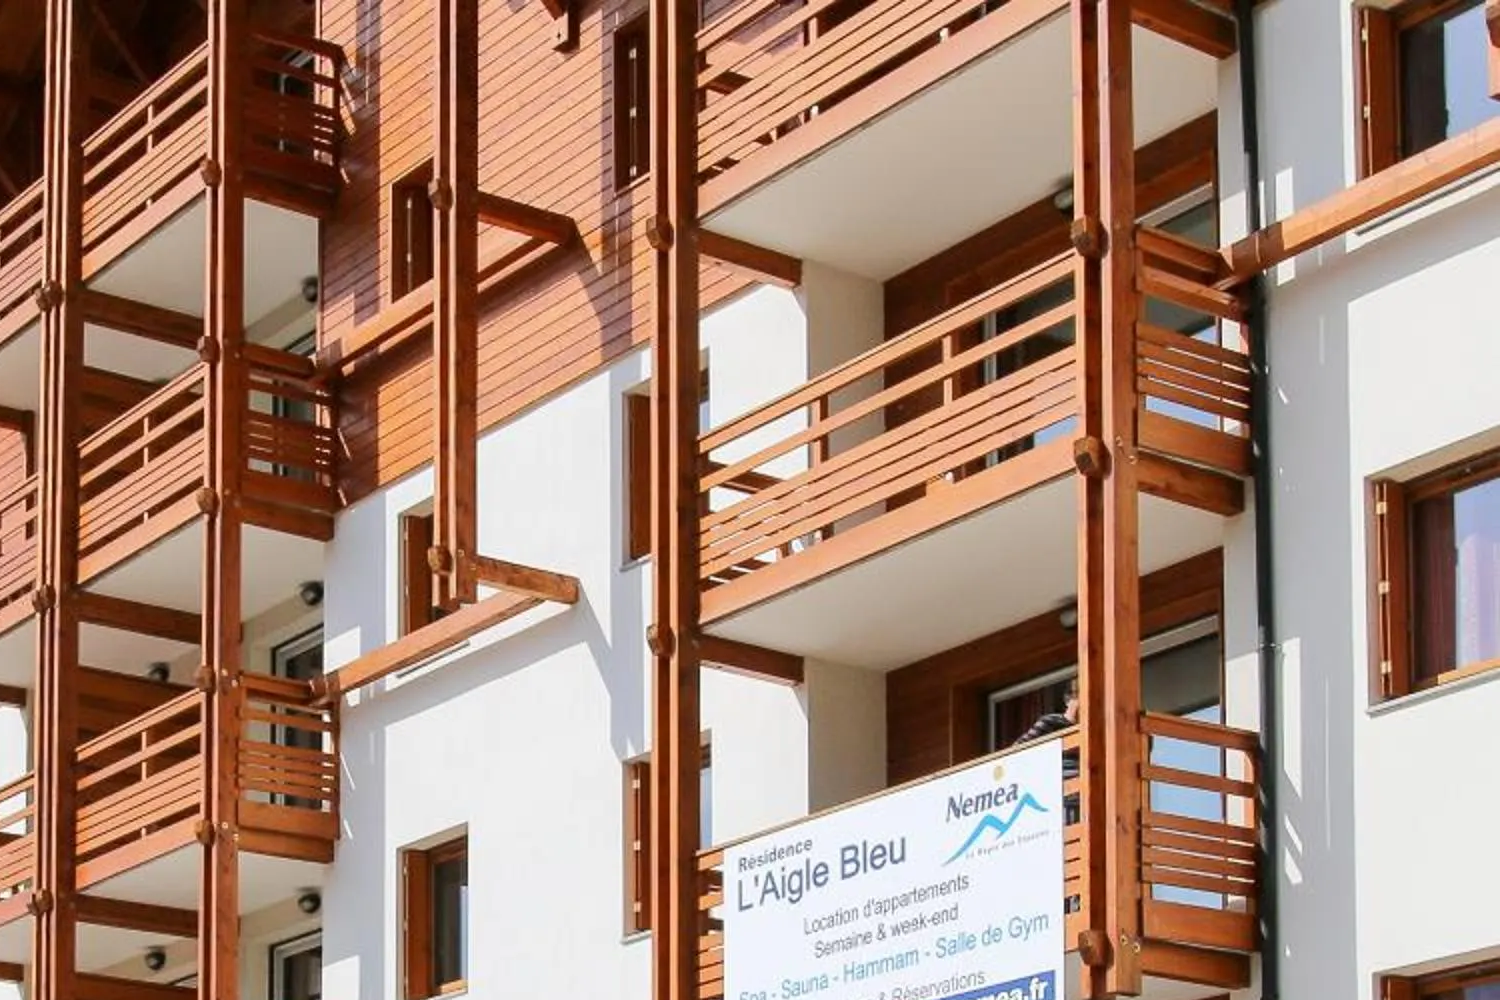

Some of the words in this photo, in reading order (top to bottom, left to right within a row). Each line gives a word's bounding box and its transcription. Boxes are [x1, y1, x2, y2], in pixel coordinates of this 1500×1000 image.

[738, 857, 829, 911] L'Aigle
[840, 836, 906, 880] Bleu
[739, 839, 812, 873] Résidence
[804, 905, 859, 935] Location
[864, 874, 969, 918] d'appartements
[815, 930, 873, 958] Semaine
[876, 923, 887, 941] &
[891, 903, 959, 937] week-end
[781, 973, 829, 1000] Sauna
[843, 949, 919, 984] Hammam
[935, 931, 977, 959] Salle
[981, 924, 1002, 947] de
[1008, 912, 1049, 942] Gym
